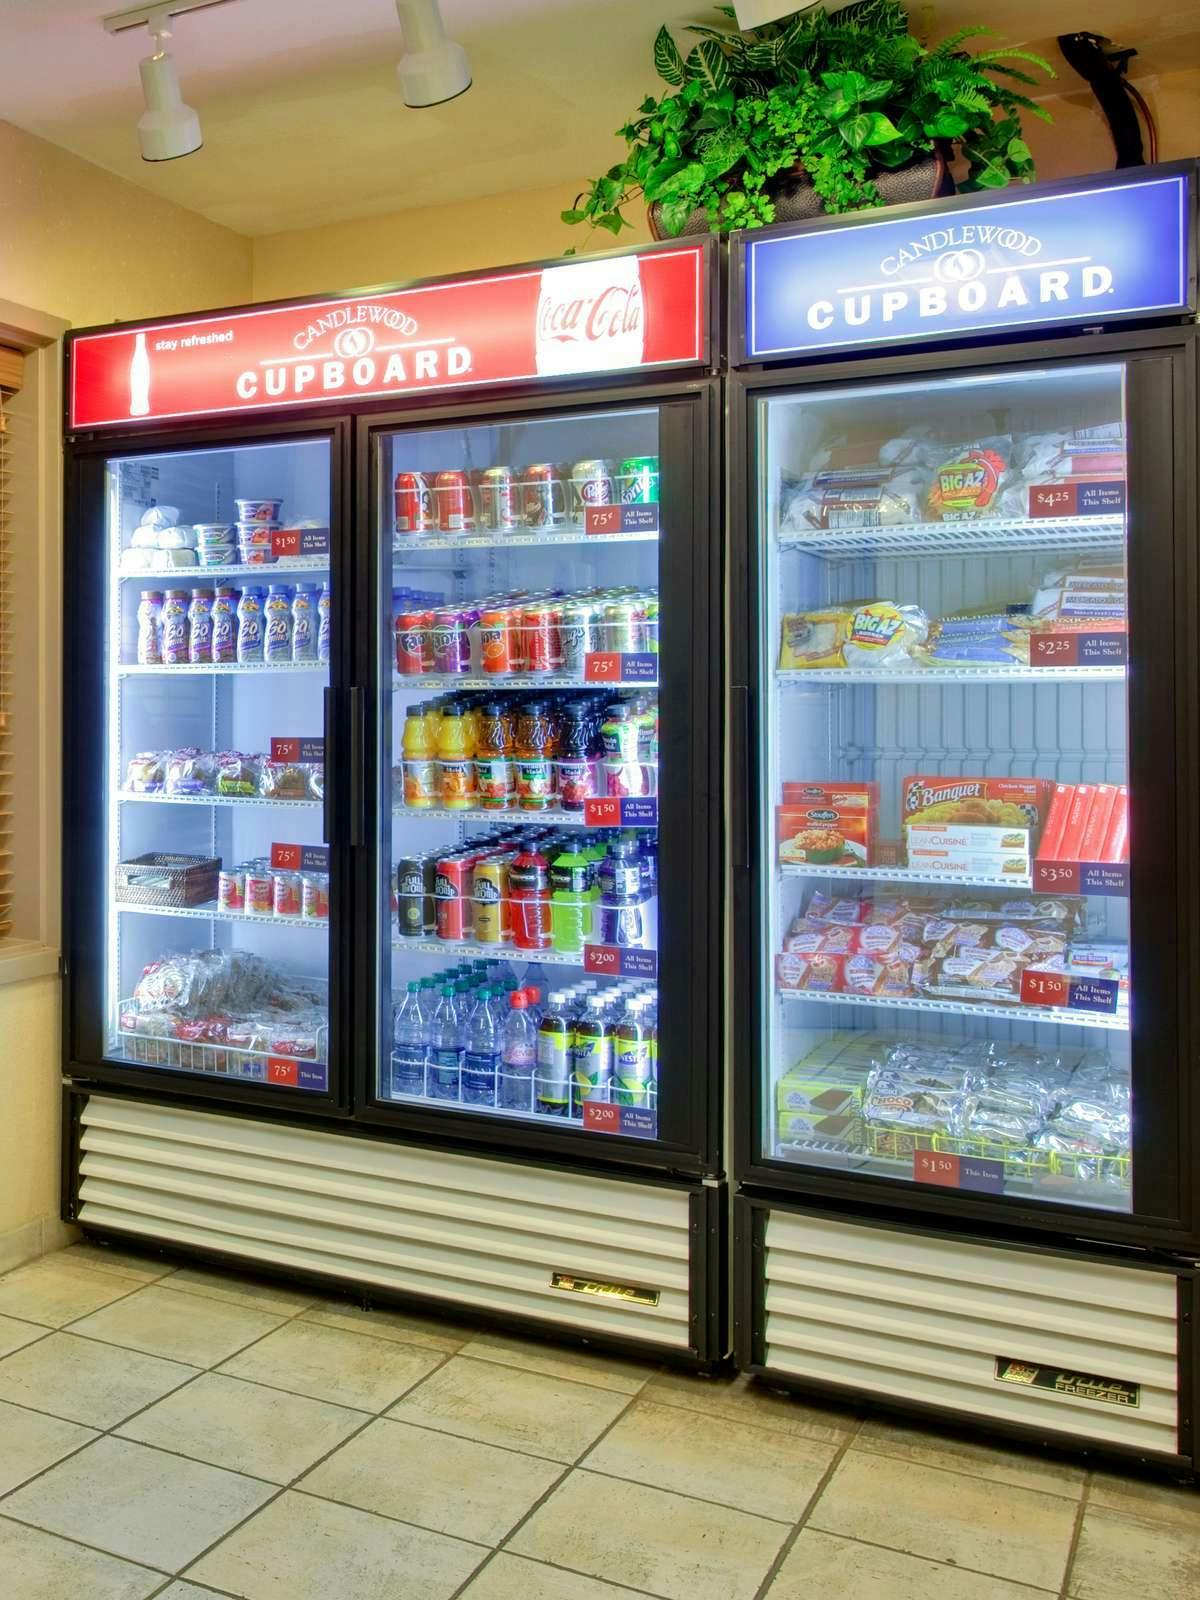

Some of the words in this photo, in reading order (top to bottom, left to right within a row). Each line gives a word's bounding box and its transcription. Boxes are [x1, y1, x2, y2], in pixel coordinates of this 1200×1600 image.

[880, 225, 1042, 276] CANDLEWOOD
[293, 305, 419, 350] CANDLEWOOD
[155, 339, 178, 352] stay
[180, 329, 233, 349] refreshed
[941, 473, 963, 493] BIG
[963, 469, 986, 489] AZ
[854, 613, 877, 631] BIG
[876, 618, 902, 637] AZ
[922, 782, 981, 807] Banquet
[1056, 1382, 1129, 1404] FREEZER
